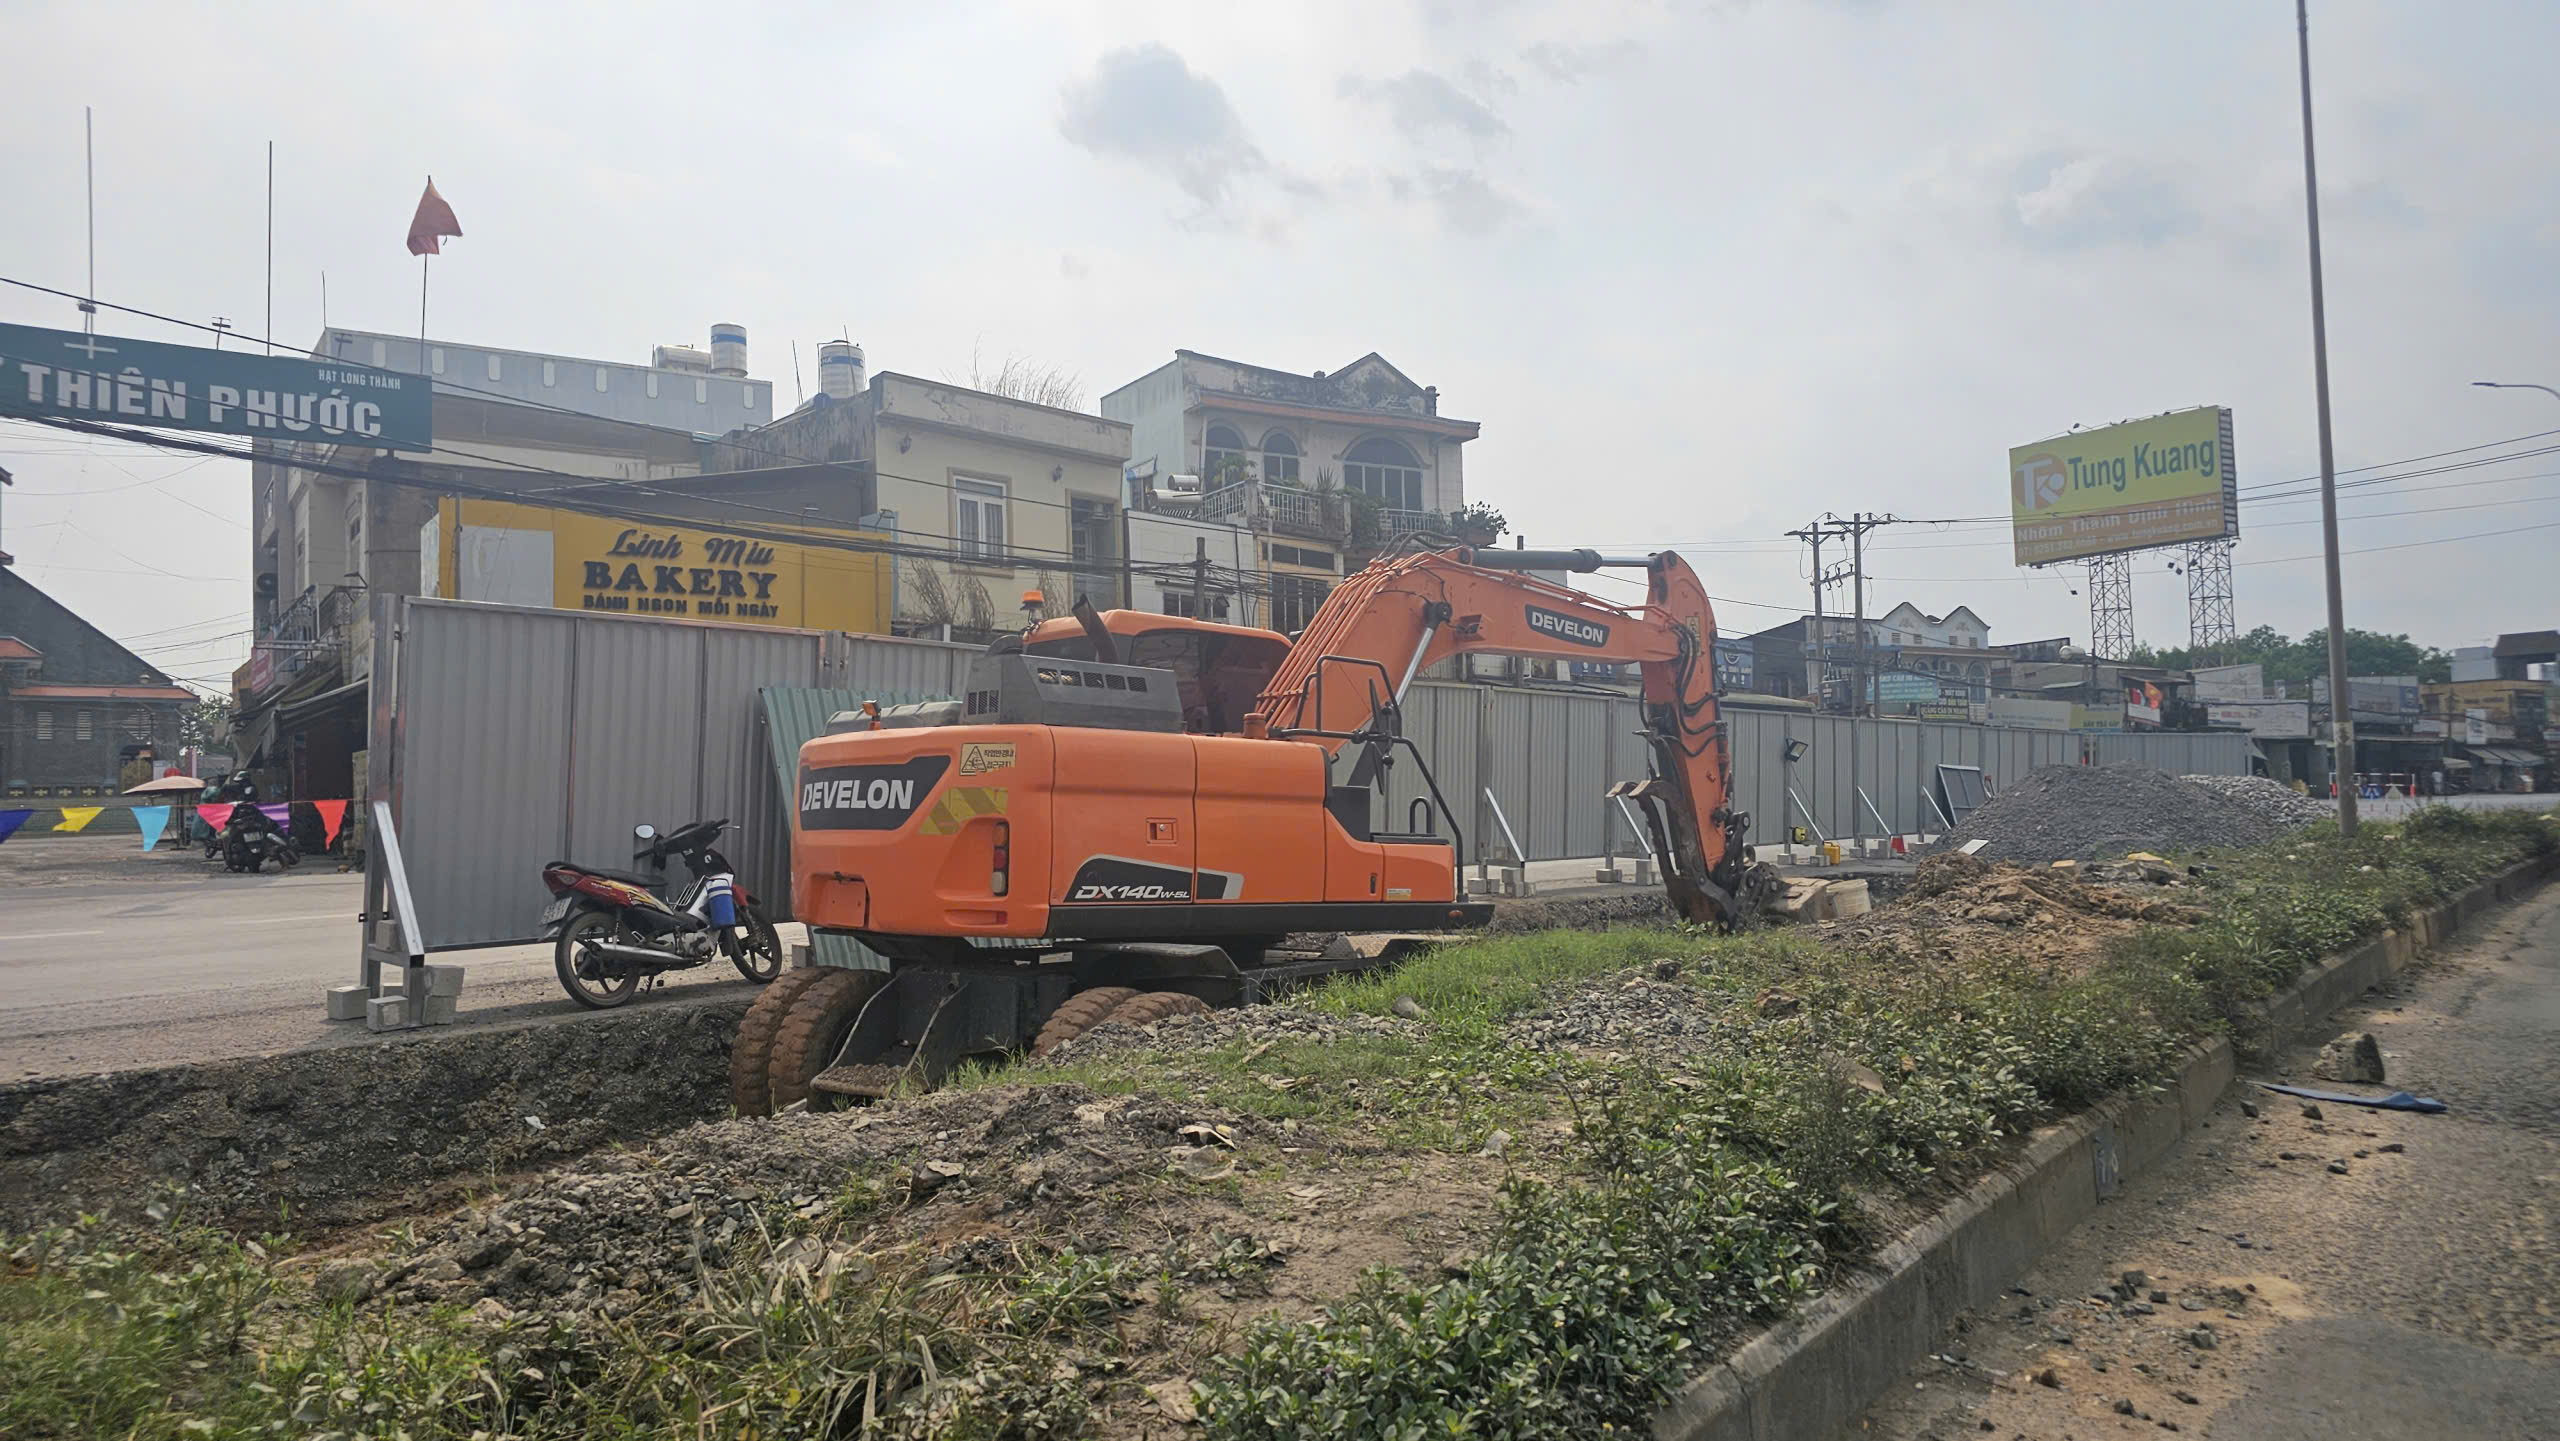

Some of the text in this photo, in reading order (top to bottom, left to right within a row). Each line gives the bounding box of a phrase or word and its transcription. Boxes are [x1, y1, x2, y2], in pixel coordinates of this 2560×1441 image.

[318, 369, 401, 390] HẠT LONG THÀNH
[20, 363, 382, 439] THIÊN PHƯỚC
[2068, 440, 2216, 492] Tung Kuang
[606, 528, 775, 567] Linh Miu
[583, 560, 778, 599] BAKERY
[583, 592, 629, 610] BÁNH
[637, 597, 688, 614] NGON
[736, 601, 779, 618] NGÀY
[1531, 610, 1604, 644] DEVELON
[801, 779, 914, 812] DEVELON
